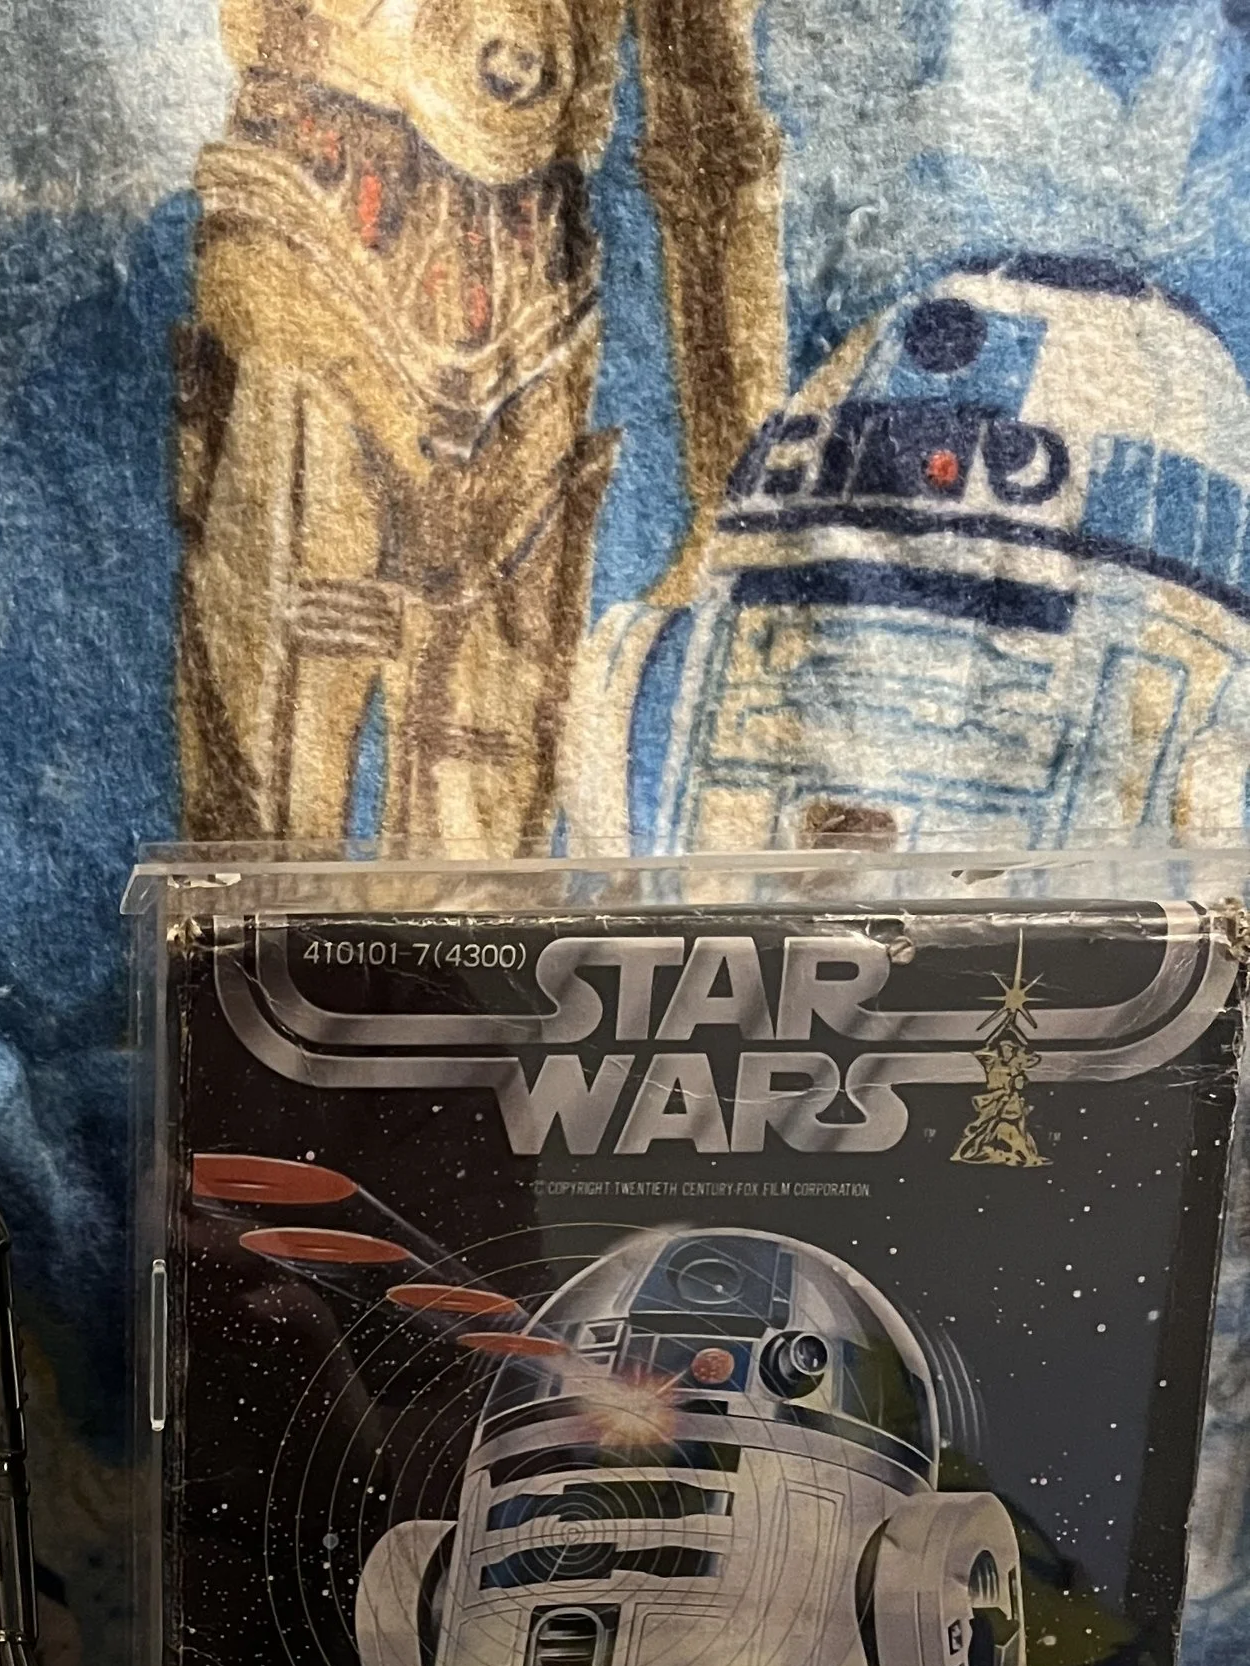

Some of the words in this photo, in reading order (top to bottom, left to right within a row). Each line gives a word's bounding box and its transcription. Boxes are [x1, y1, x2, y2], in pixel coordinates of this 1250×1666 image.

[303, 941, 527, 970] 410101-7(4300)
[536, 936, 892, 1043] STAR
[492, 1052, 910, 1155] WARS
[548, 1181, 611, 1196] COPYRIGHT
[615, 1181, 678, 1197] TWENTIETH
[762, 1182, 791, 1197] FILM
